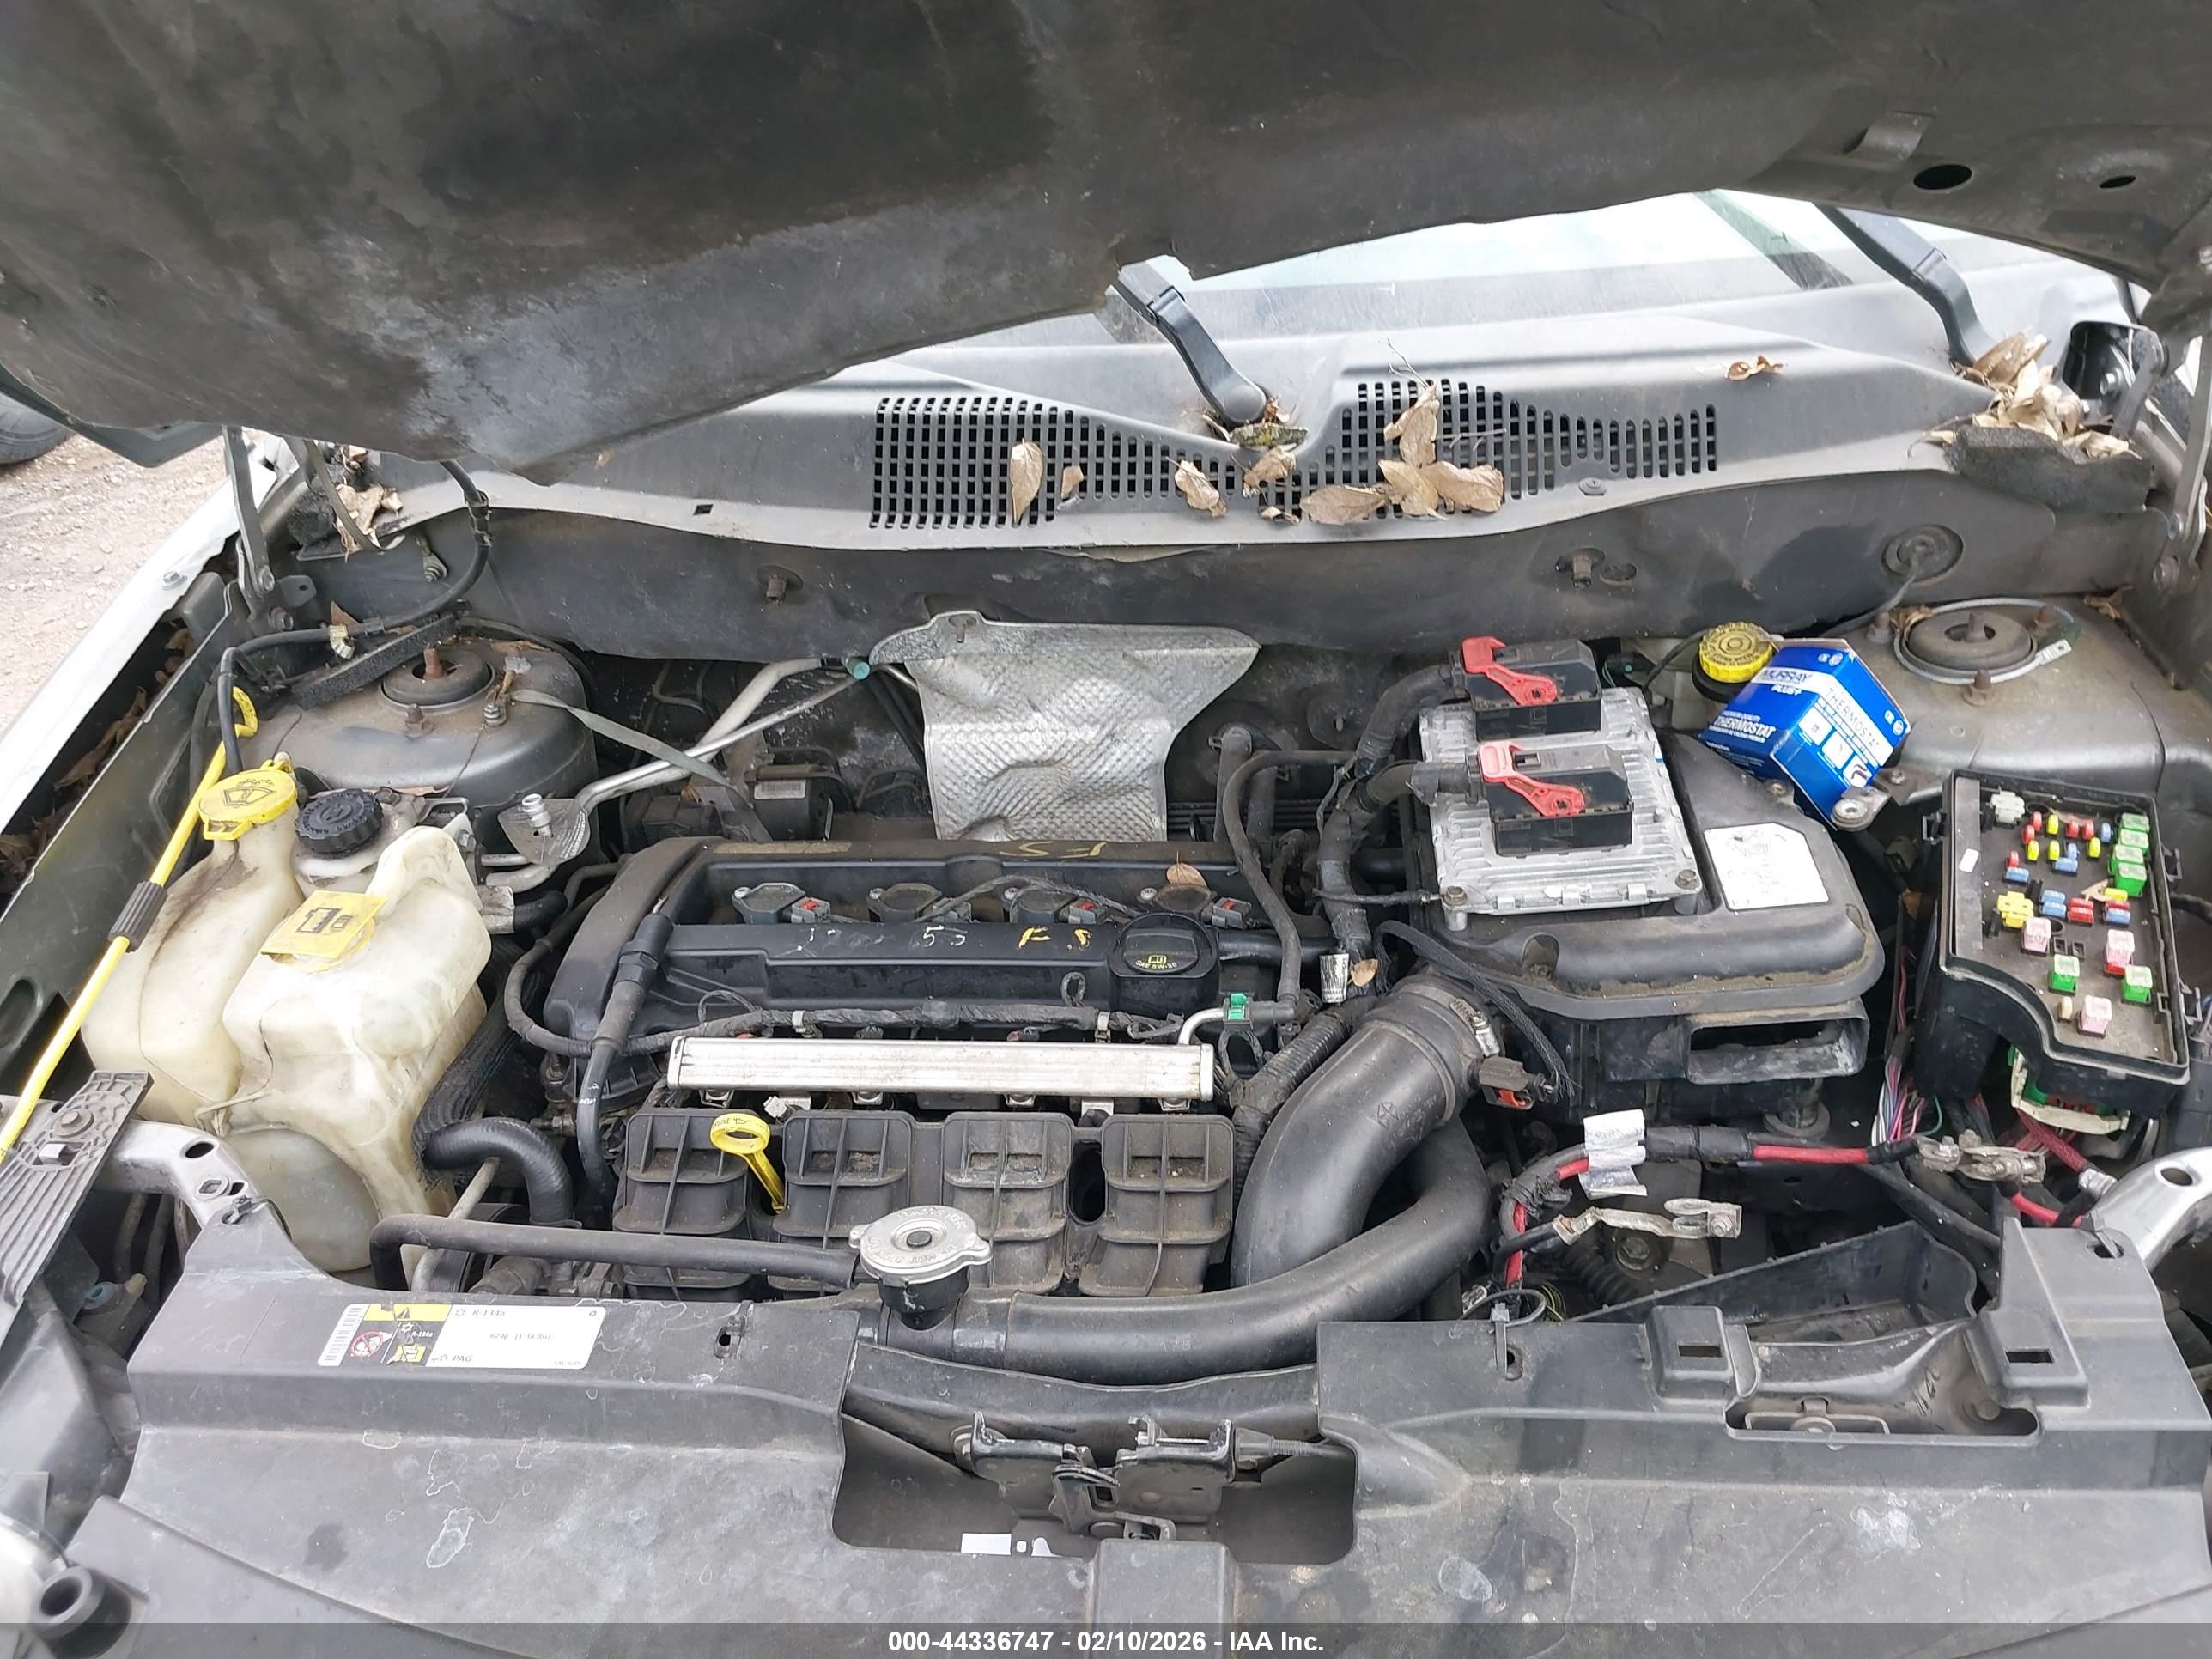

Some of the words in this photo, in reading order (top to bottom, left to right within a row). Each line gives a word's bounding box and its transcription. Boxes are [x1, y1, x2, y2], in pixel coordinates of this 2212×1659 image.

[1714, 715, 1777, 738] THERMOSTAT
[1826, 687, 1881, 750] THERMOSTAT
[1135, 960, 1150, 969] SAE
